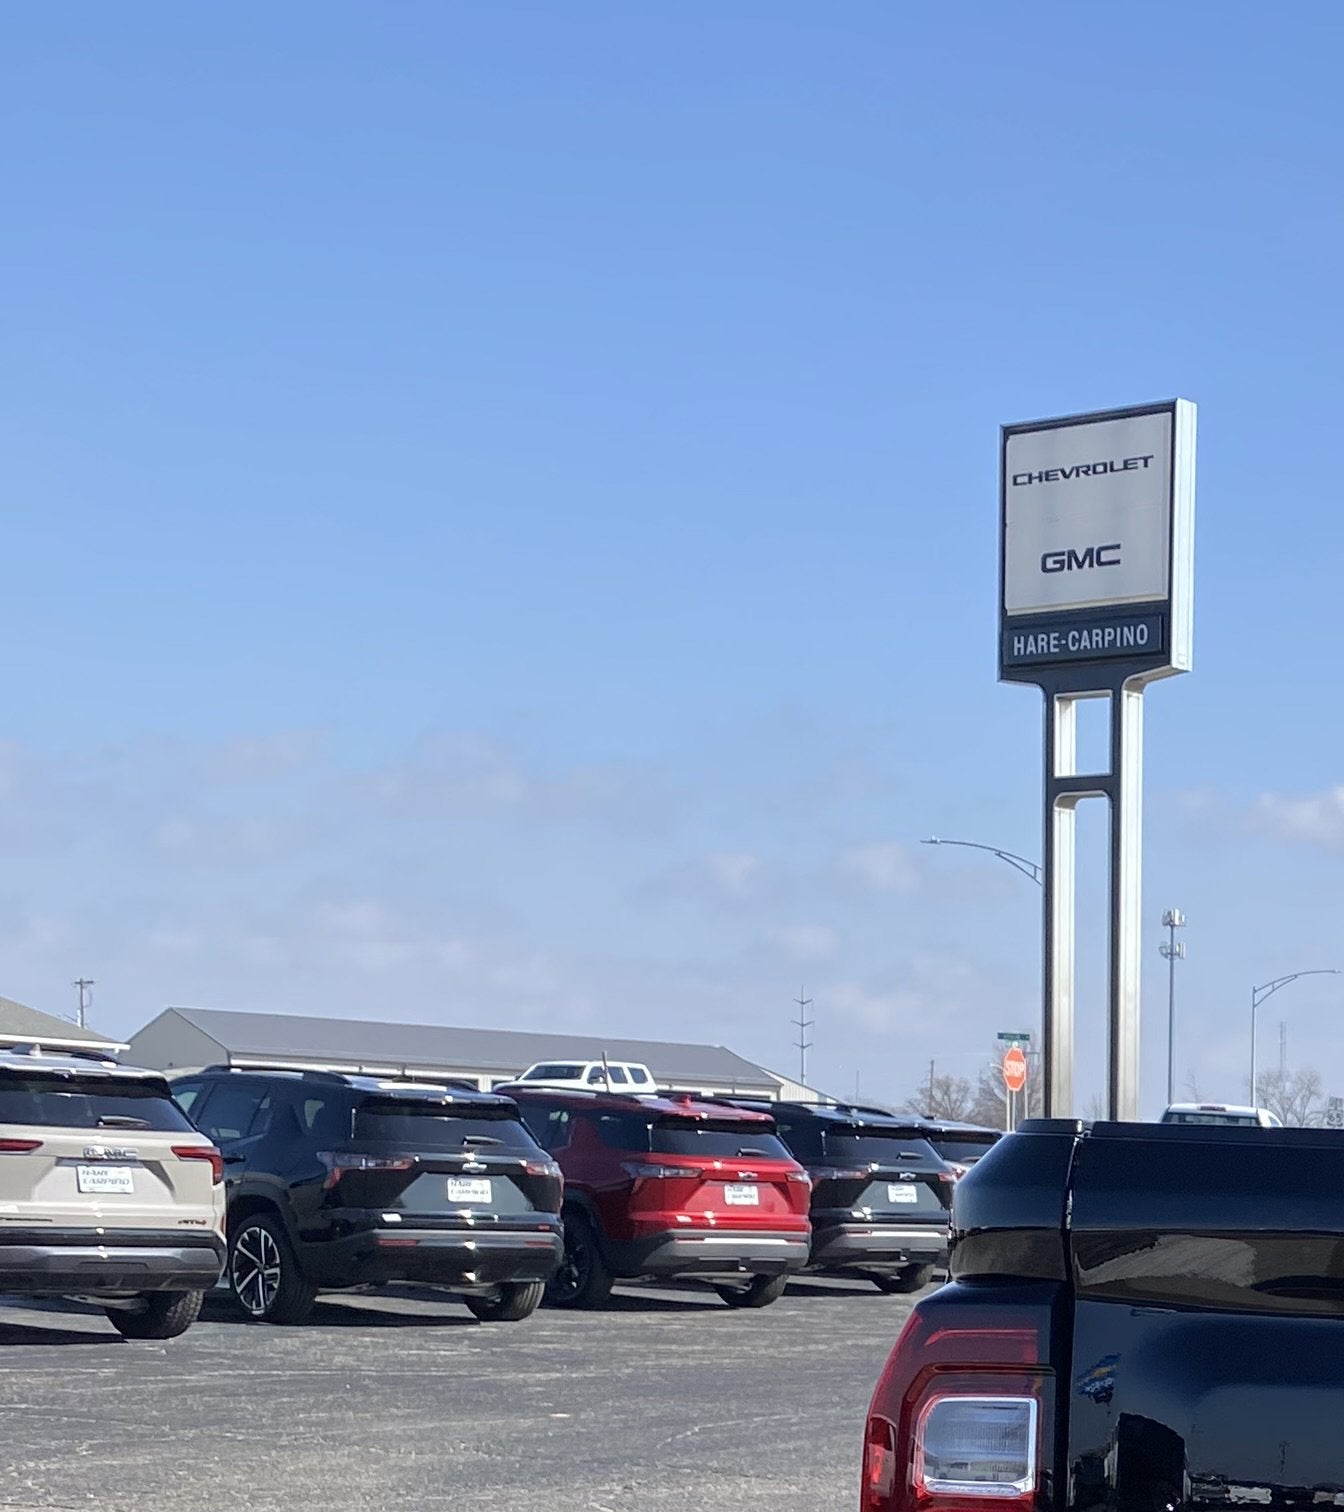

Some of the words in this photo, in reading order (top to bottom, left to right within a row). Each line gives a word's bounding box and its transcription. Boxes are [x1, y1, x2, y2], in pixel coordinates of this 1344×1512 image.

[1012, 455, 1154, 486] CHEVROLET
[1041, 544, 1121, 573] GMC
[1013, 624, 1148, 656] HARE-CARPINO
